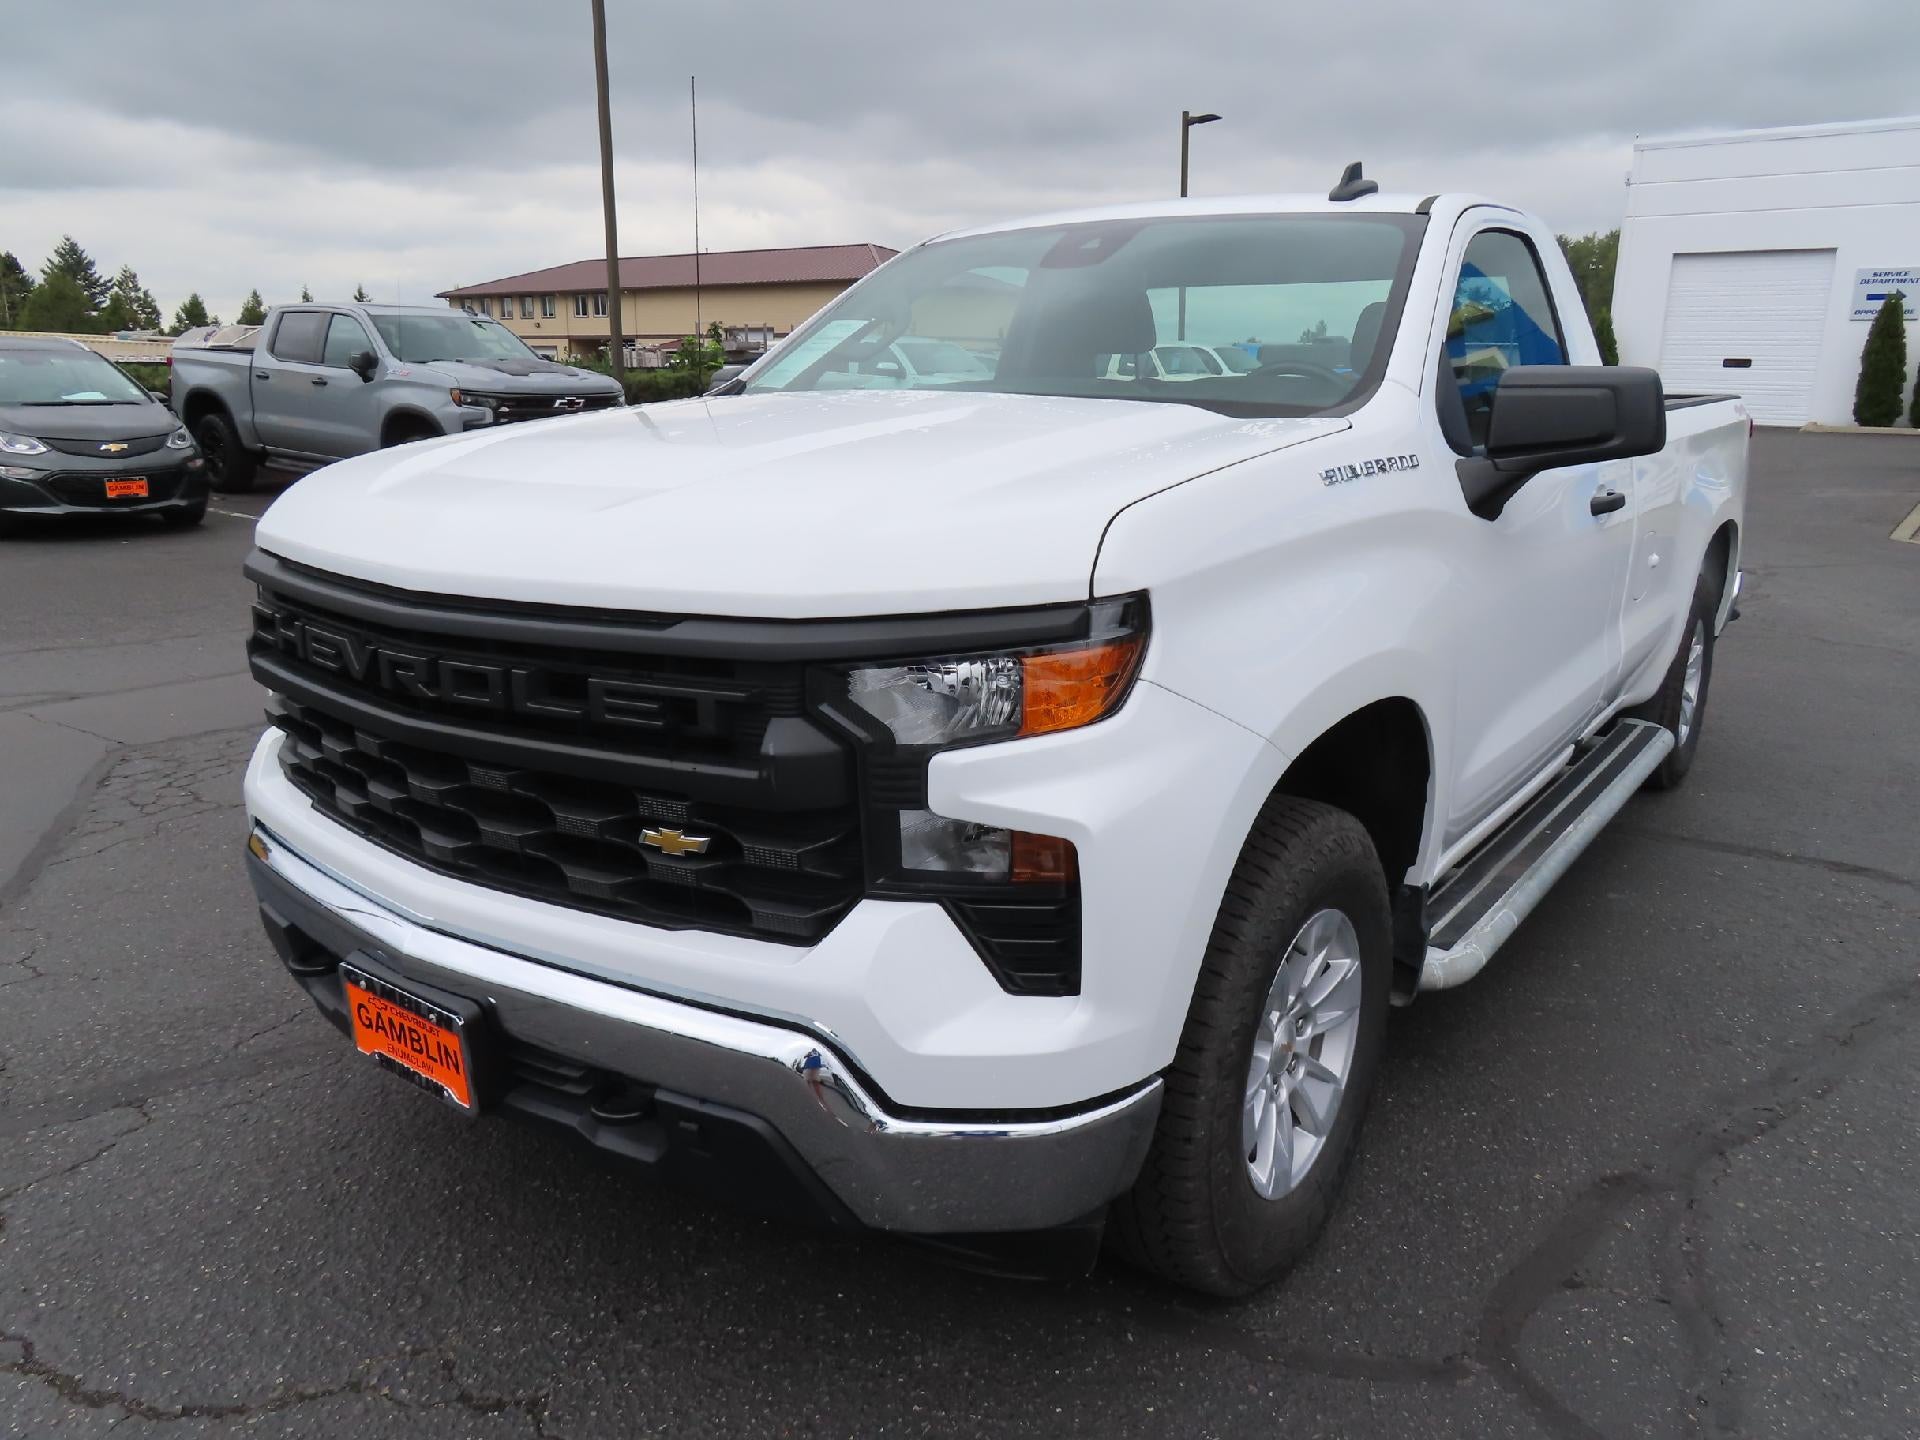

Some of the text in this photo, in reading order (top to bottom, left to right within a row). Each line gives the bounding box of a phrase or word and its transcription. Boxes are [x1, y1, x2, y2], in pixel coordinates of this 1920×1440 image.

[1319, 454, 1420, 487] SILVERADO
[252, 603, 764, 736] CHEVROLET
[357, 1002, 461, 1075] GAMBLIN
[387, 1043, 434, 1075] ENUMCLAW
